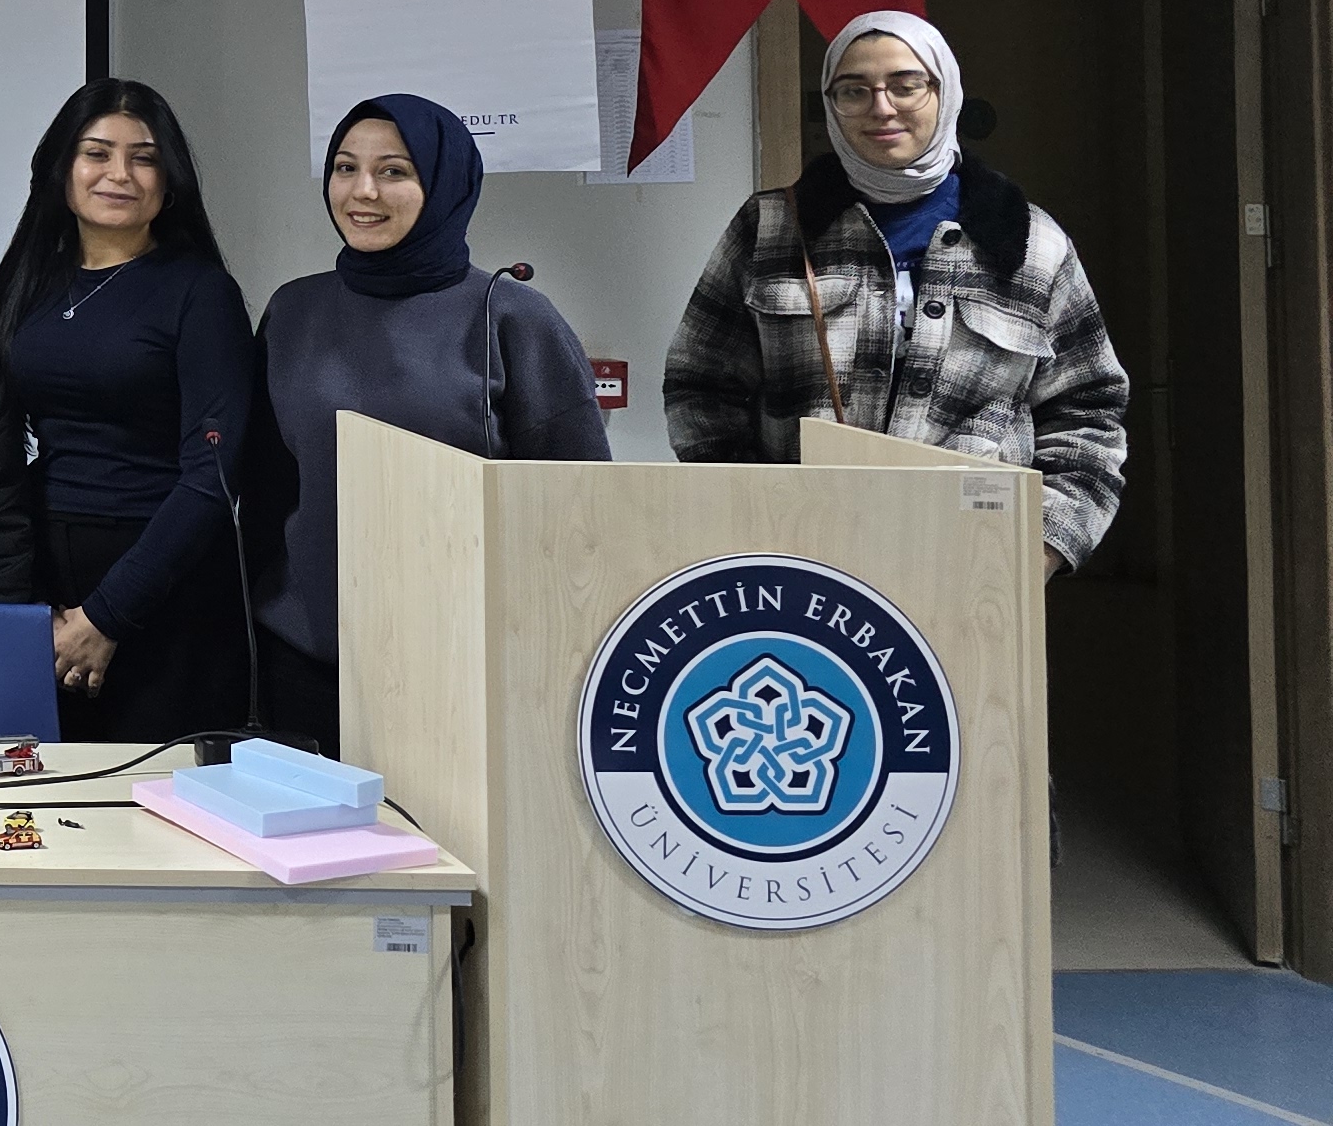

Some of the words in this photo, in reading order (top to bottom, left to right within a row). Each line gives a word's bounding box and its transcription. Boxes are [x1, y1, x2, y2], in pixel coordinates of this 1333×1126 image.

[610, 581, 783, 753] NECMETTİN
[804, 592, 930, 755] ERBAKAN
[630, 802, 919, 904] ÜNİVERSİTESİ
